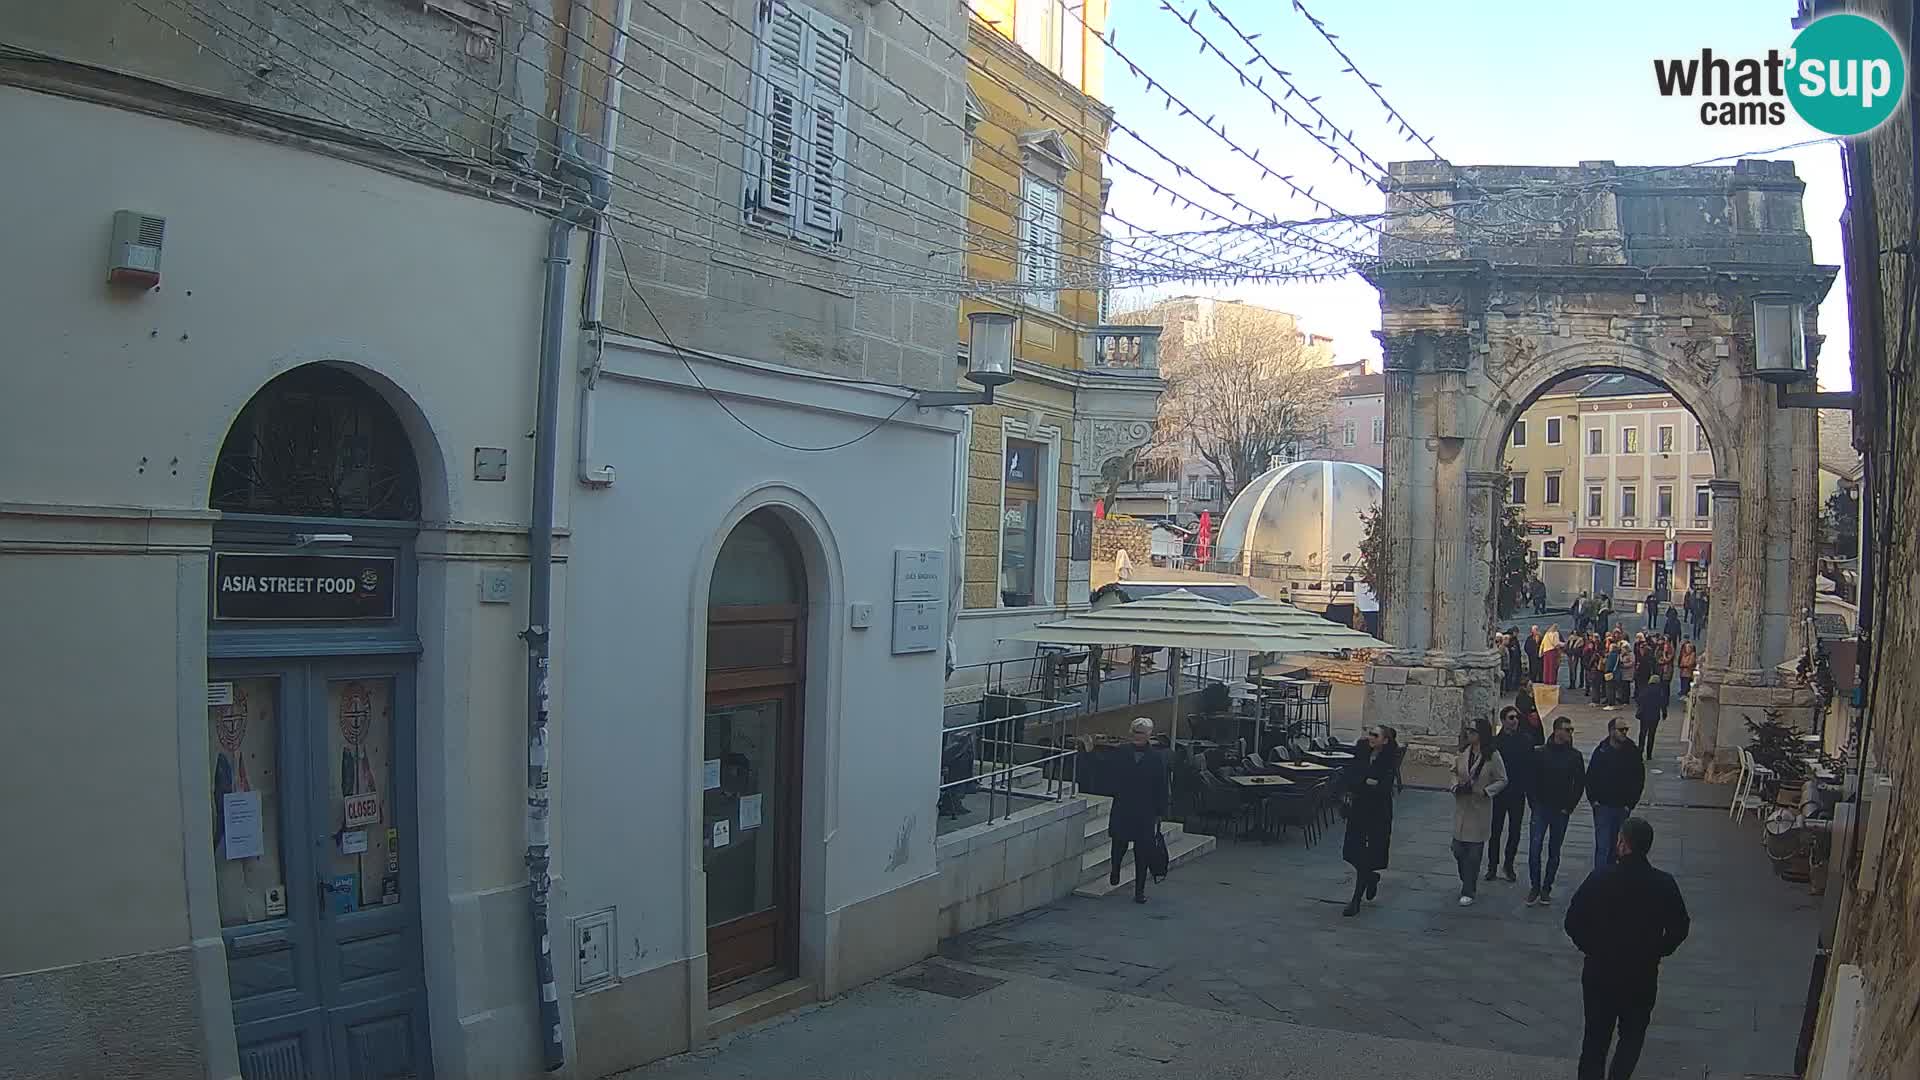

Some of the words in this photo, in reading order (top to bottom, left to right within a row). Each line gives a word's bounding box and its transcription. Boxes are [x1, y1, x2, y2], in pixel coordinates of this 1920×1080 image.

[222, 576, 256, 592] ASIA
[259, 576, 313, 593] STREET
[317, 578, 355, 593] FOOD
[348, 800, 376, 819] CLOSED
